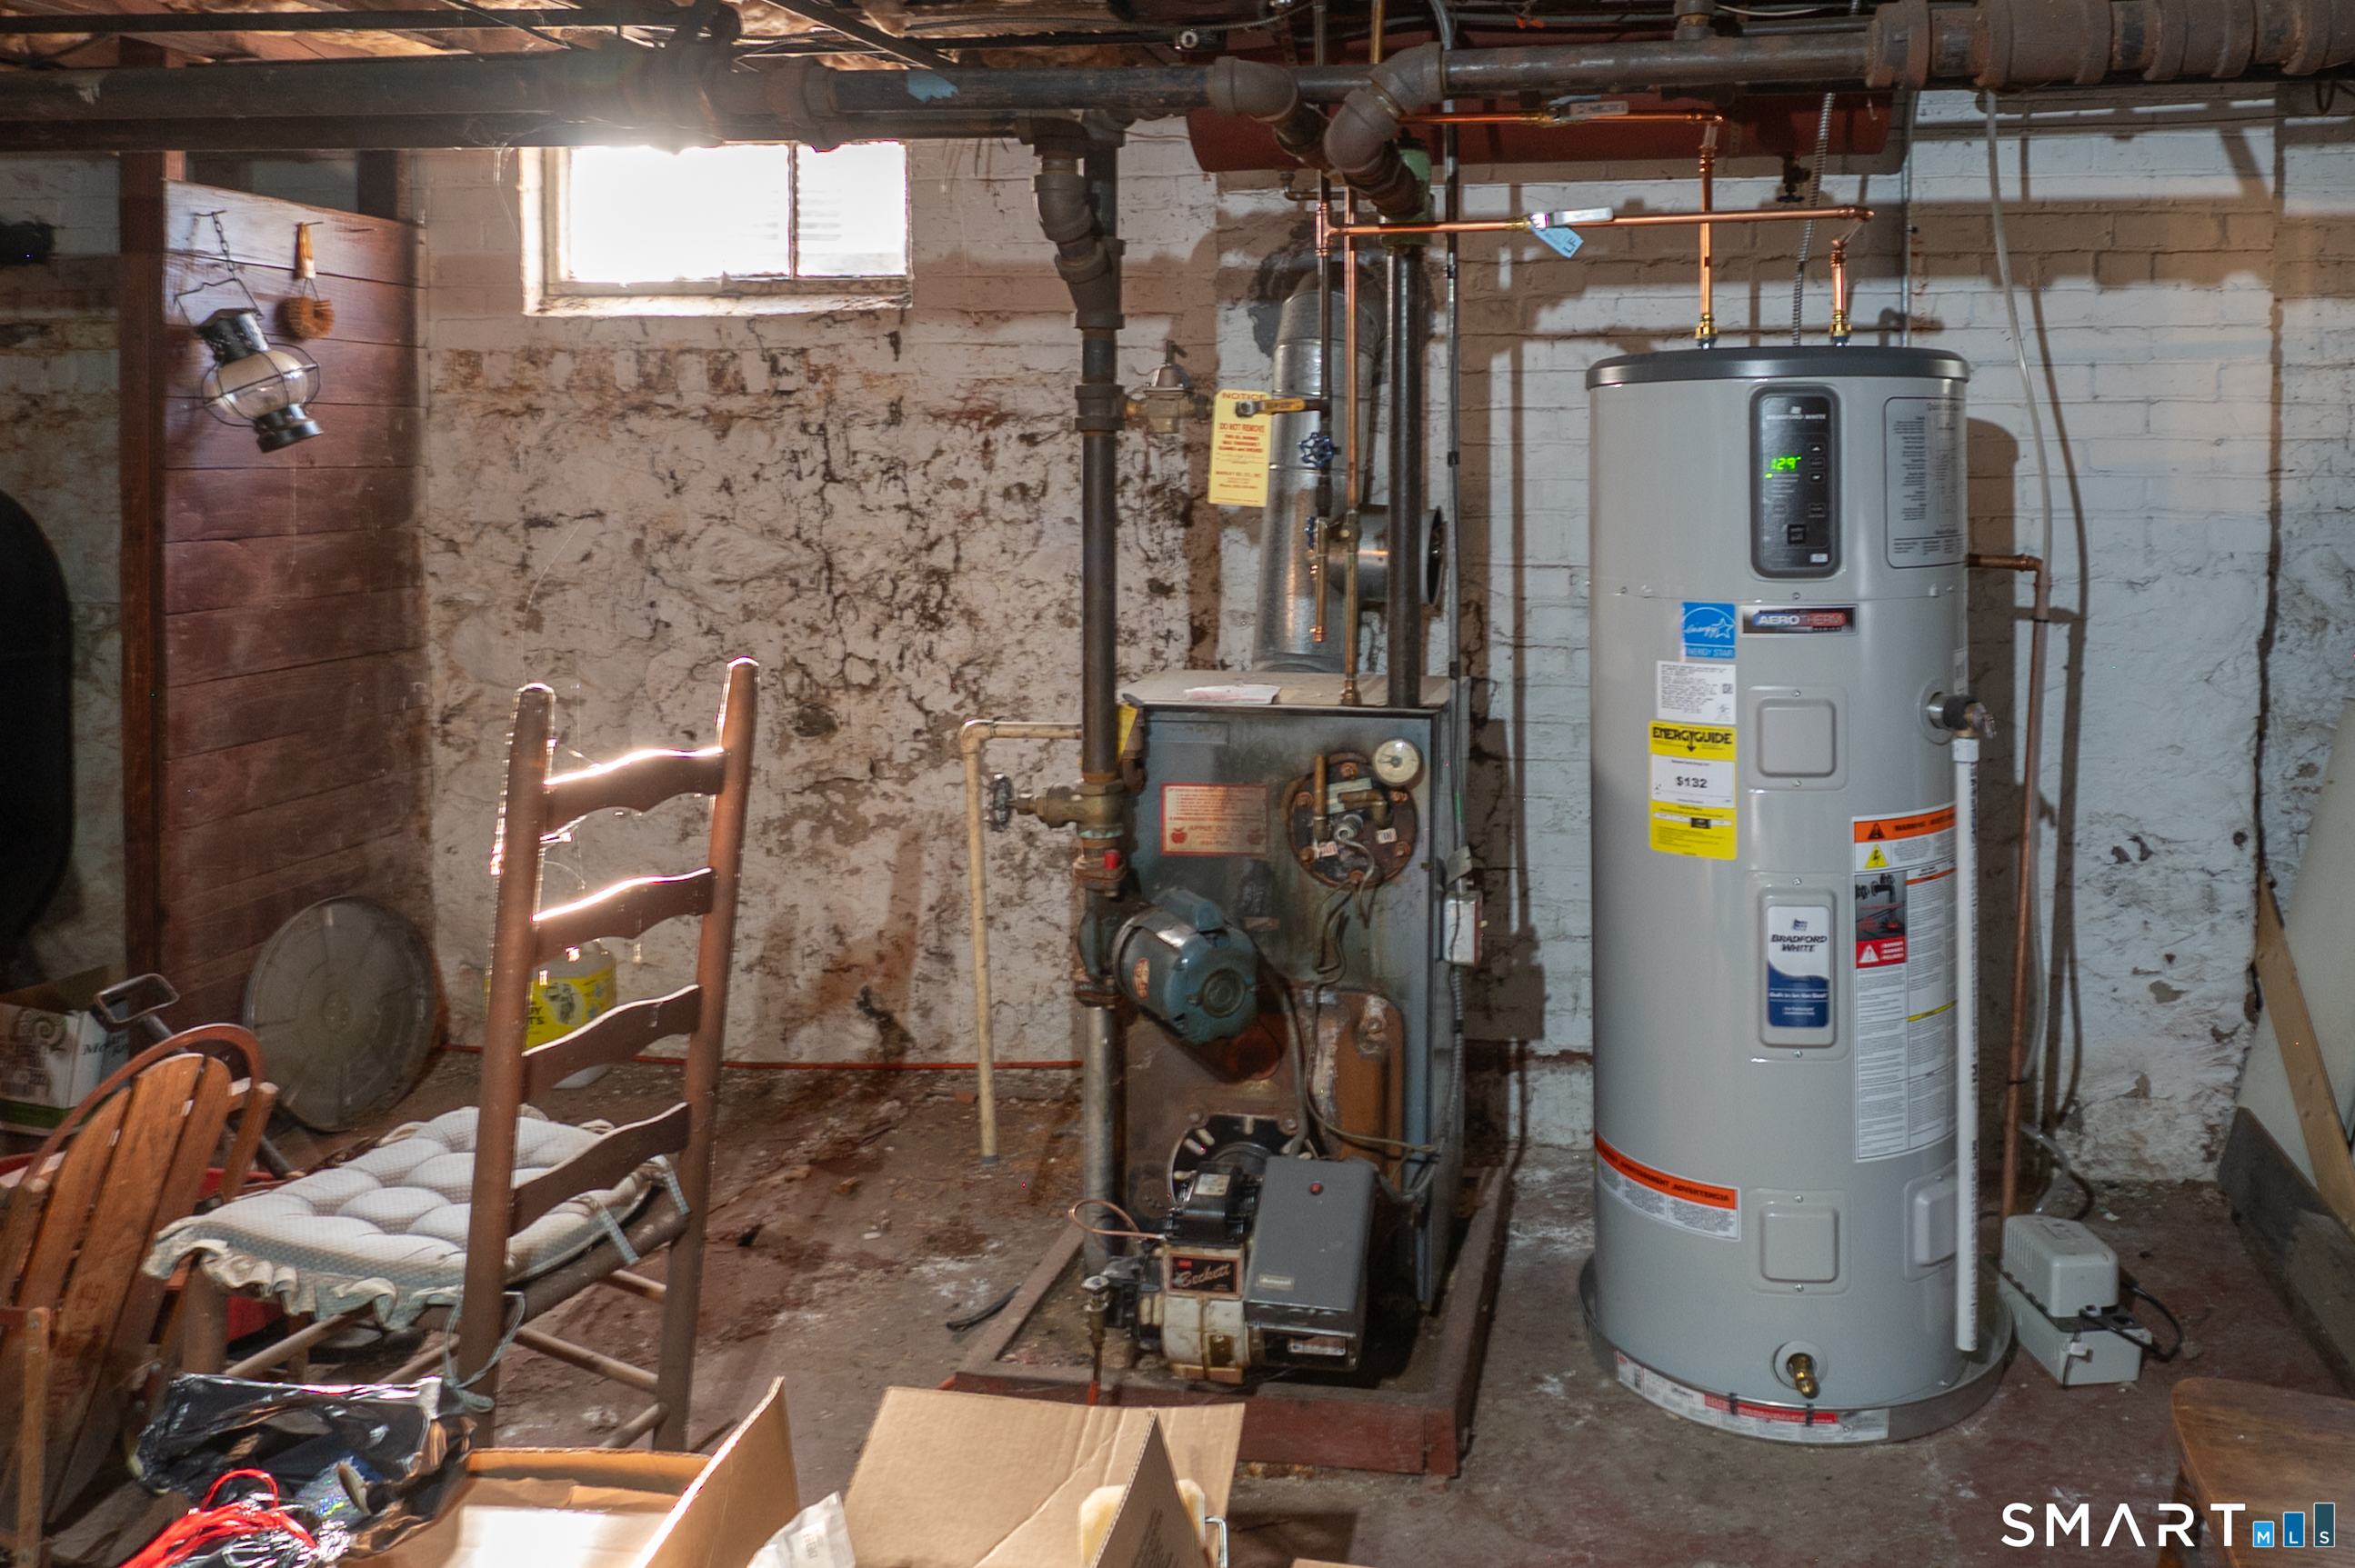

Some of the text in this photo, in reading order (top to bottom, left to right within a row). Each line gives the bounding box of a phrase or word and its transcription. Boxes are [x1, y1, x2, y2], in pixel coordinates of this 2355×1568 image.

[1221, 392, 1267, 401] NOTICE
[1229, 423, 1241, 432] NOT
[1242, 424, 1265, 433] REMOVE
[1713, 648, 1734, 656] STAR
[1676, 775, 1708, 788] $132
[1771, 934, 1828, 943] BRADFORD
[1781, 944, 1817, 952] WHITE
[1179, 1263, 1232, 1288] Beckett
